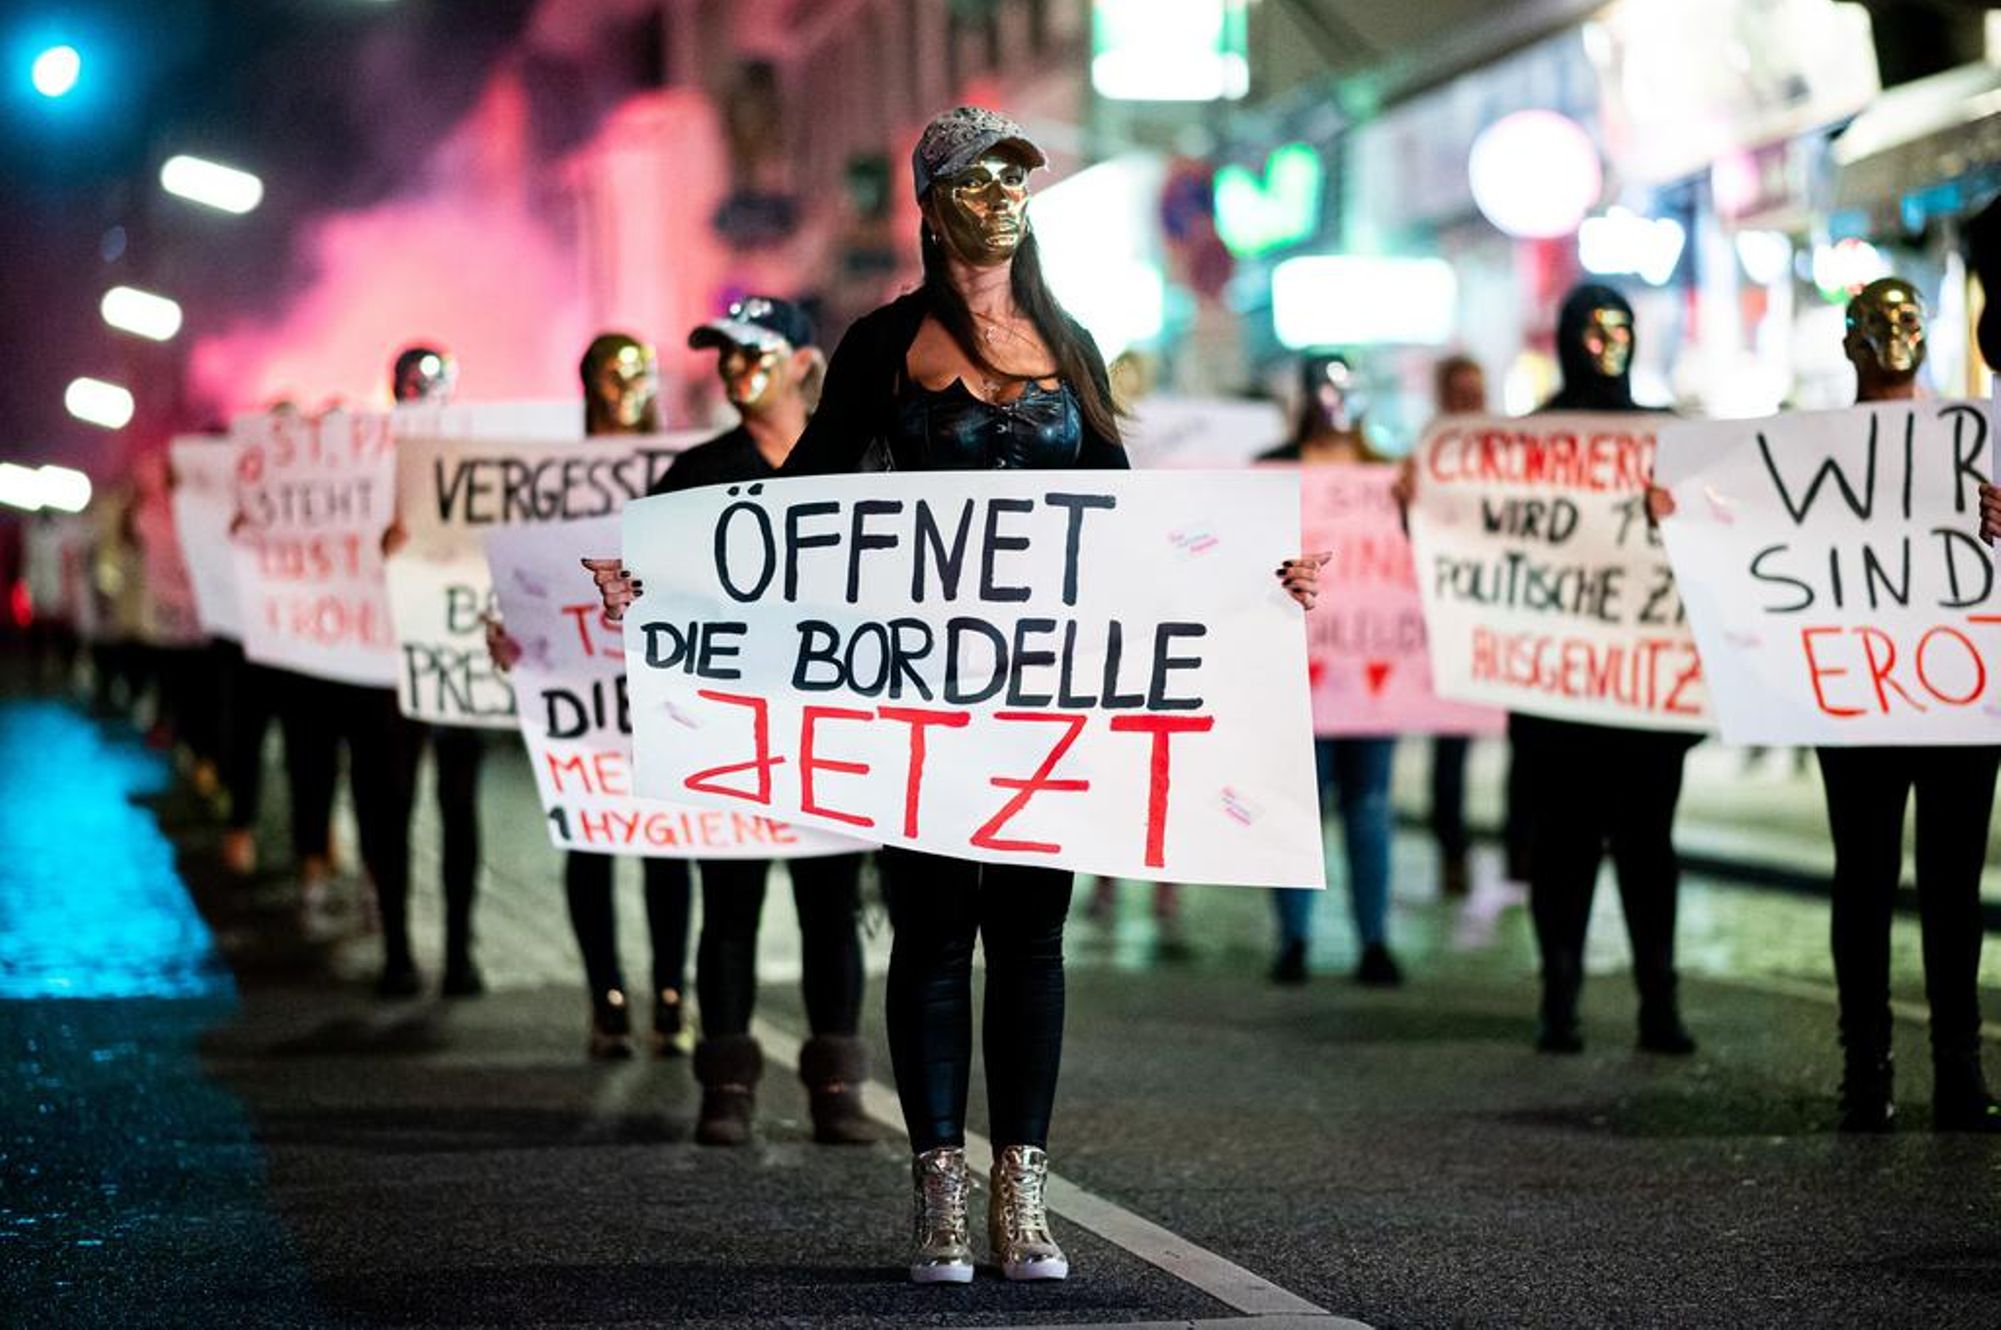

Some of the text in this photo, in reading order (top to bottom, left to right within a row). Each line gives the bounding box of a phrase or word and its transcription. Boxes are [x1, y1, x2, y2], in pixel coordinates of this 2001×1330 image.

[435, 448, 677, 522] VERGESST
[1757, 405, 1990, 524] WIR
[714, 483, 1116, 606] ÖFFNET
[1482, 499, 1579, 544] WIRD
[1434, 553, 1625, 623] POLITISCHE
[1750, 529, 1994, 613] SIND
[641, 617, 1207, 711] DIE BORDELLE
[684, 689, 1214, 868] JETZT
[579, 810, 798, 845] HYGIENE
